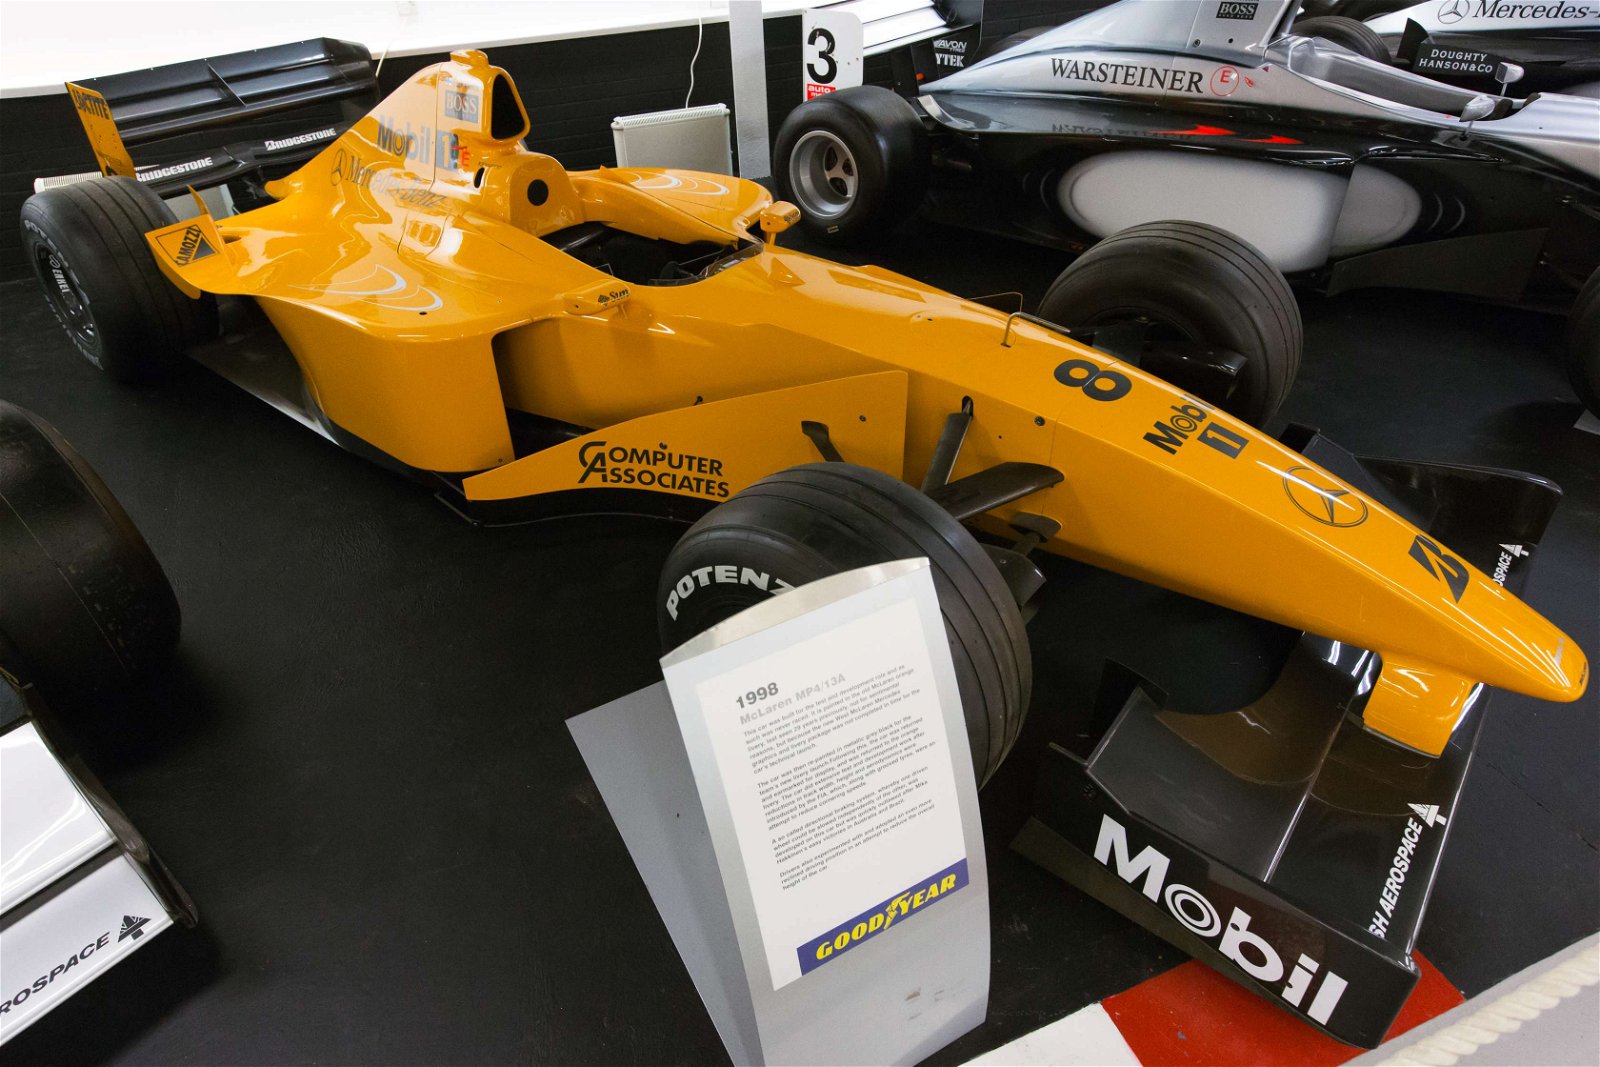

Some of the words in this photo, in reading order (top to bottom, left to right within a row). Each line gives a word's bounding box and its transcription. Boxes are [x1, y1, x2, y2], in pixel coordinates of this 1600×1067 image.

[1220, 3, 1256, 15] BOSS
[1472, 0, 1600, 19] Mercedes-
[806, 27, 838, 84] 3
[938, 39, 967, 50] AVON
[1430, 49, 1488, 62] DOUGHTY
[1050, 57, 1204, 94] WARSTEINER
[1418, 58, 1494, 74] HANSON&CO
[446, 92, 478, 114] BOSS
[264, 128, 337, 151] BRIDGESTONE
[377, 114, 431, 165] Mobil
[52, 268, 71, 292] ENKEI
[1053, 358, 1133, 402] 8
[578, 440, 723, 477] COMPUTER
[577, 452, 730, 498] ASSOCIATES
[736, 681, 779, 709] 1998
[740, 697, 793, 725] McLaren
[795, 673, 846, 701] MP4/13A
[1378, 817, 1424, 919] AEROSPACE
[1093, 813, 1349, 1026] Mobil
